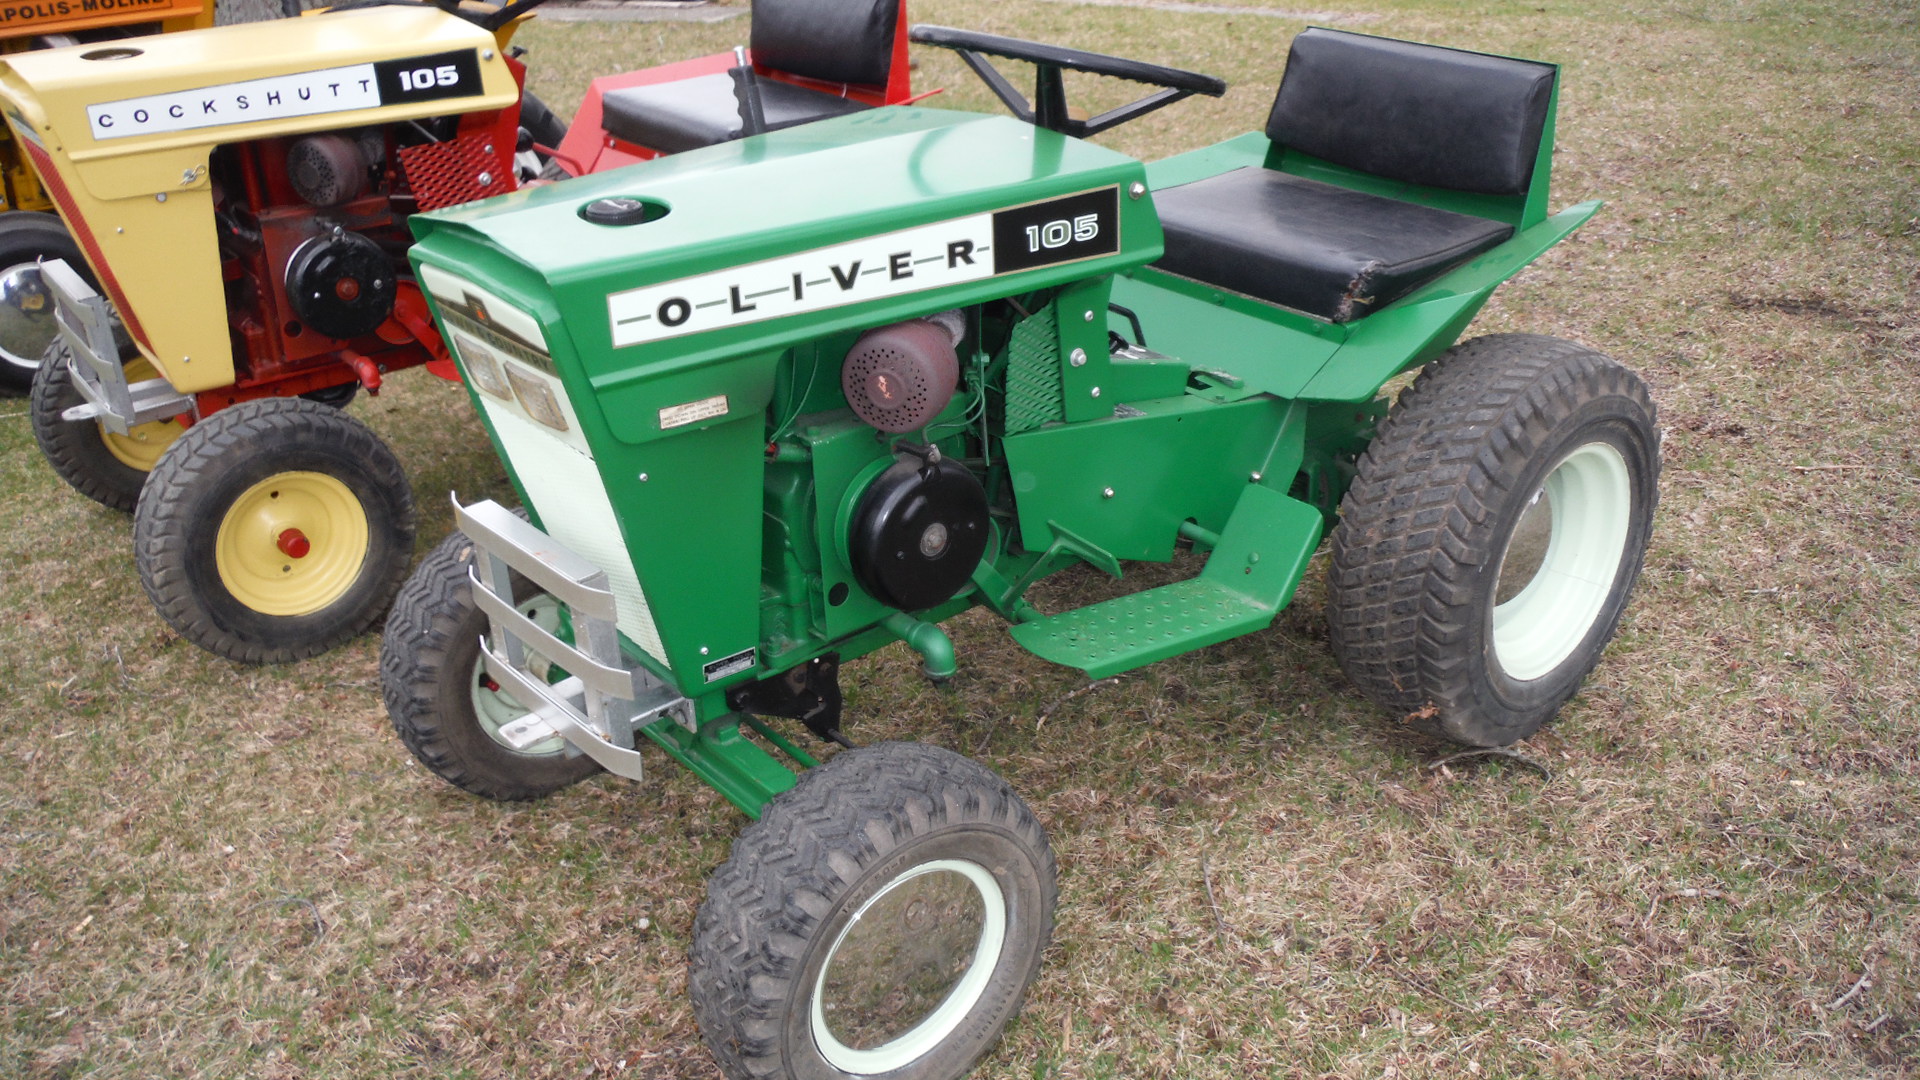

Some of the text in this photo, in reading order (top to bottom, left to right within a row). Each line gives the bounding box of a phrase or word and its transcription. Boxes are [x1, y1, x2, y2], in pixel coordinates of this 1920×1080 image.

[0, 0, 164, 21] POLIS-MOL
[98, 65, 459, 128] COCKSHUTT 105
[656, 213, 1099, 328] OLIVER 105
